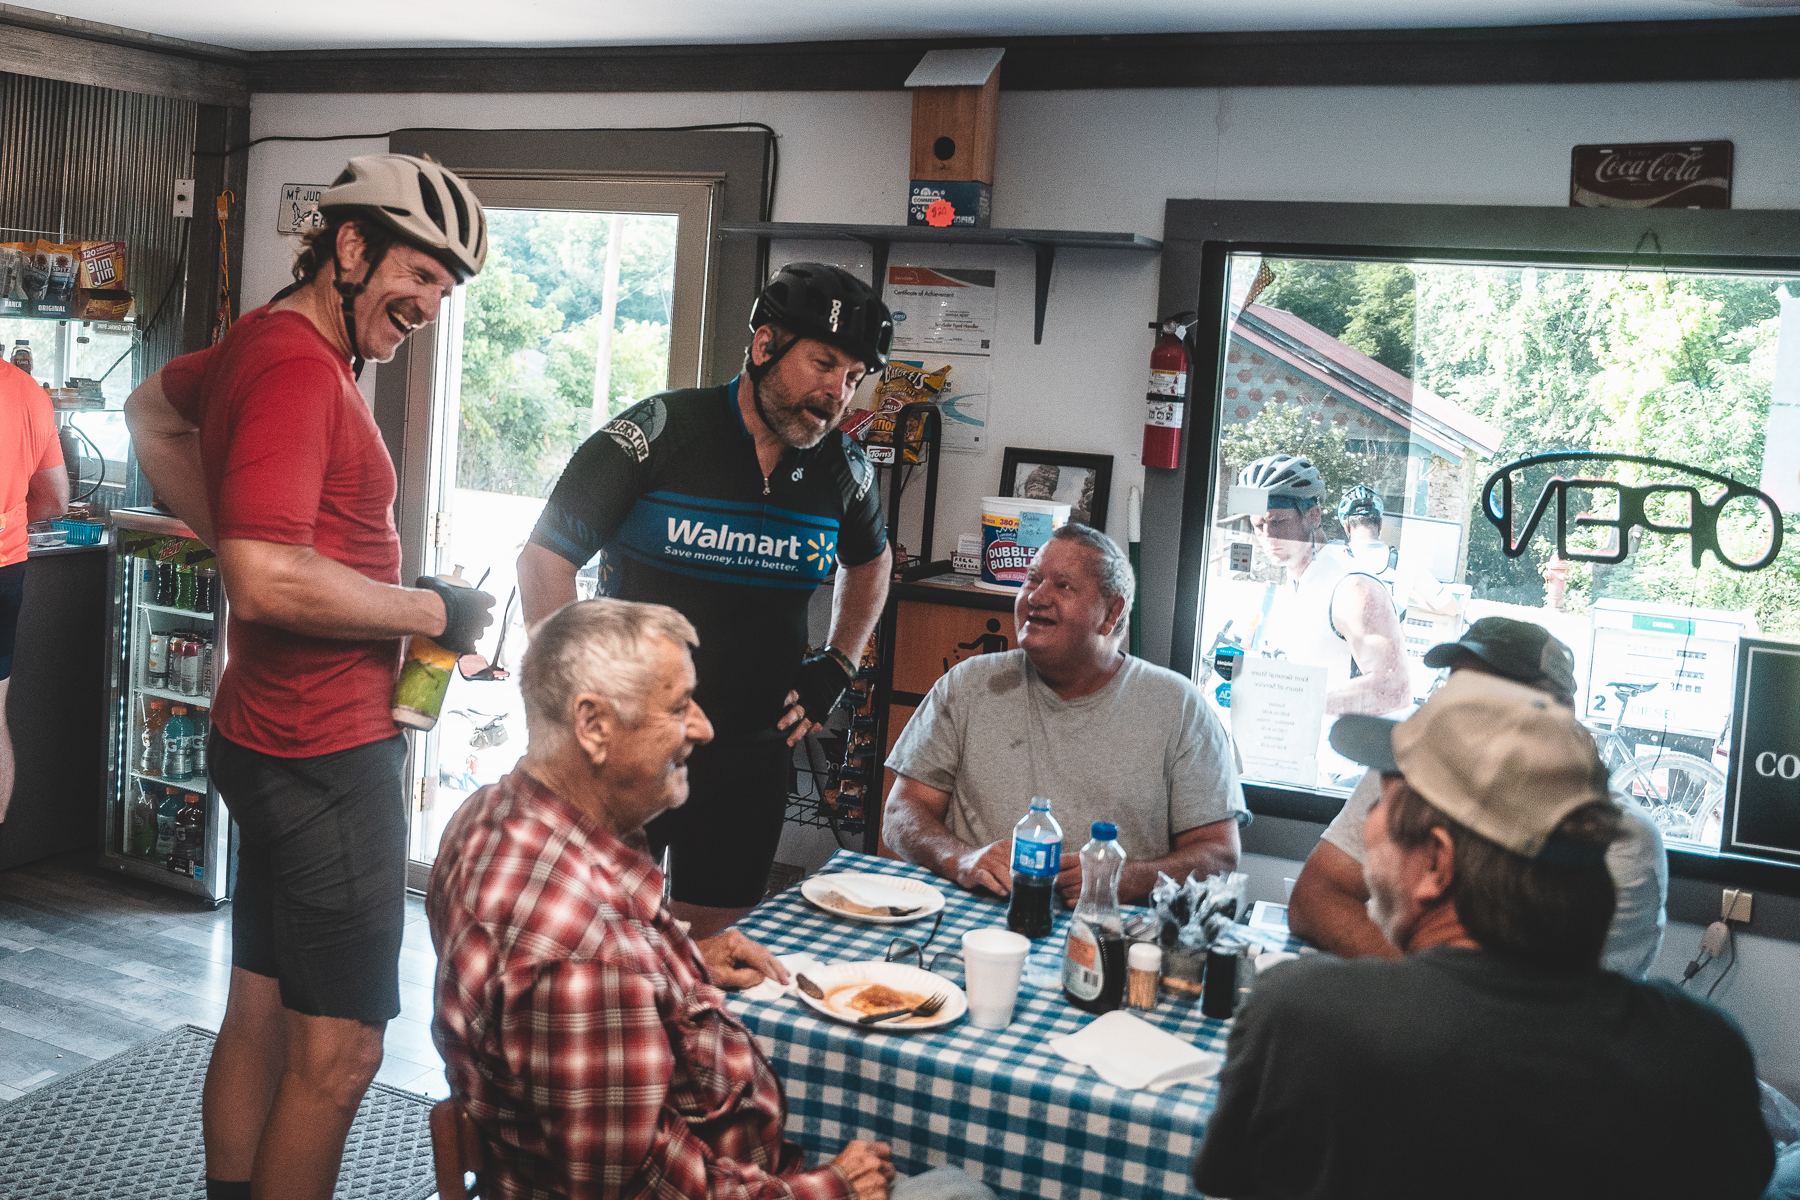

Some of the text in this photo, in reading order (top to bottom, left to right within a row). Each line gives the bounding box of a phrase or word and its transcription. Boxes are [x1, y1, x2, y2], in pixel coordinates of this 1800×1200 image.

[38, 304, 66, 313] ORIGINAL
[667, 517, 802, 561] Walmart
[664, 545, 692, 559] Save
[694, 552, 735, 566] money.
[761, 558, 799, 573] better.
[989, 546, 1036, 559] DUBBLE
[990, 557, 1033, 570] BUBBL
[1593, 695, 1607, 711] 2
